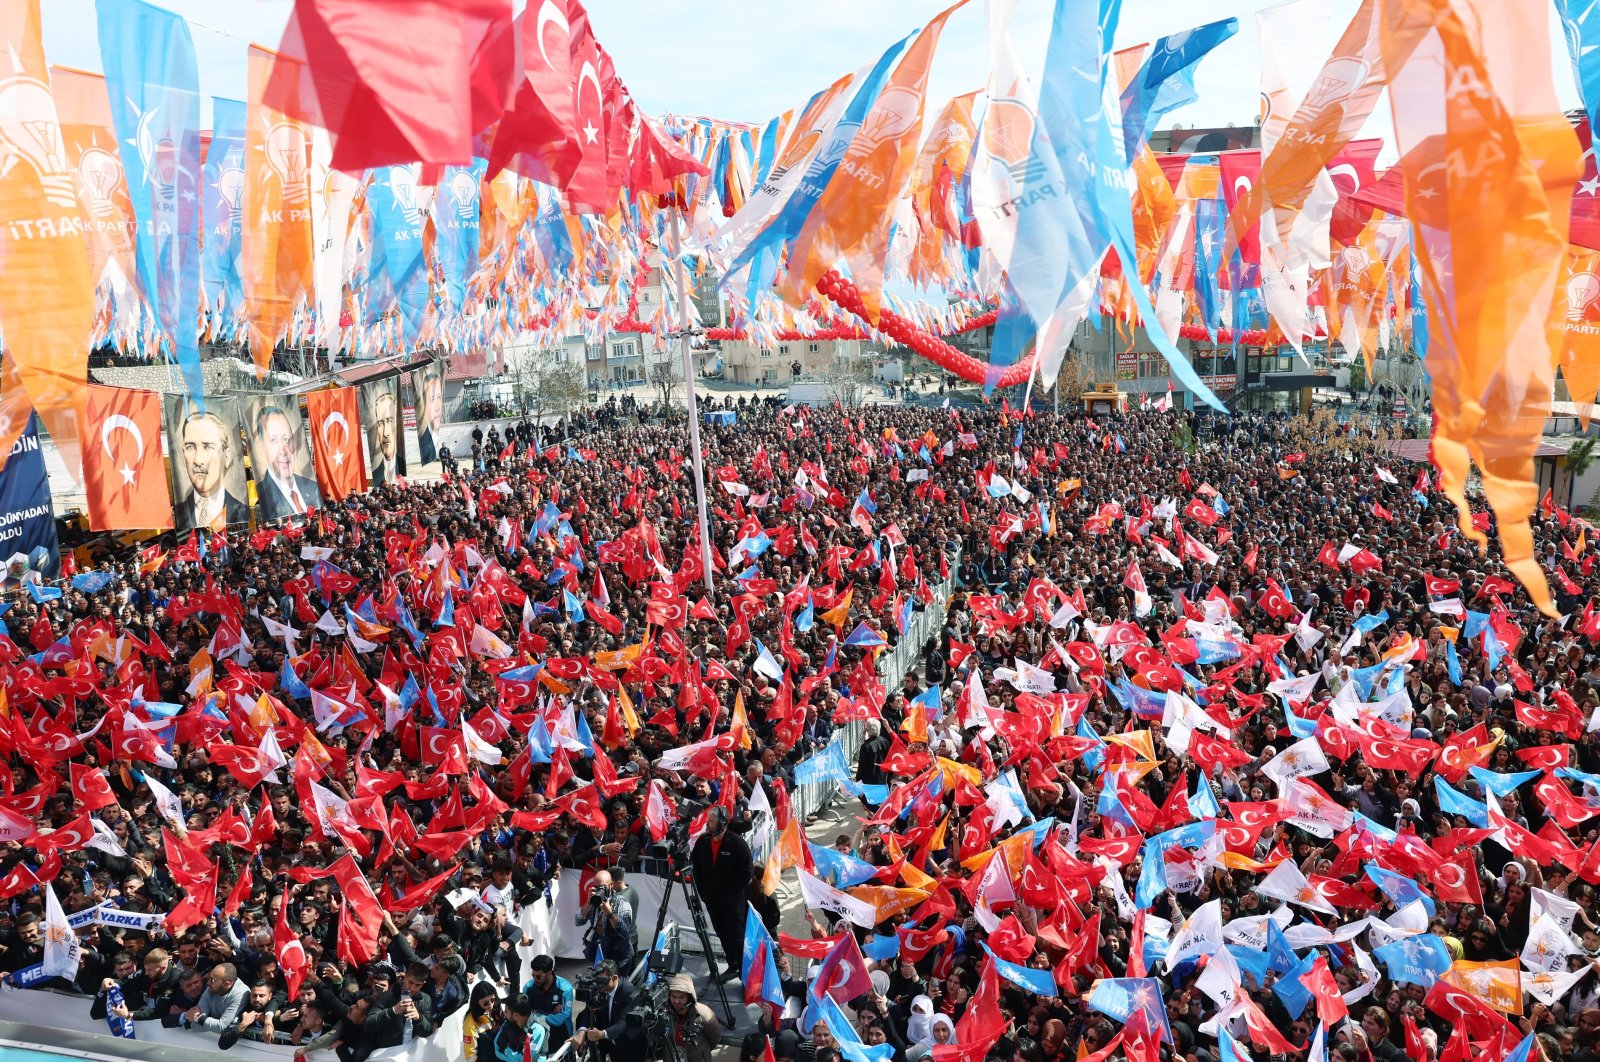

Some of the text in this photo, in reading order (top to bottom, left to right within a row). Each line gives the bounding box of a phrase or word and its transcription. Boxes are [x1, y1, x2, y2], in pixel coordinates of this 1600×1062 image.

[260, 209, 284, 223] AK
[448, 220, 460, 229] AK
[214, 225, 228, 235] AK
[395, 231, 408, 241] AK
[1298, 811, 1309, 819] AK
[100, 911, 142, 927] YARKA
